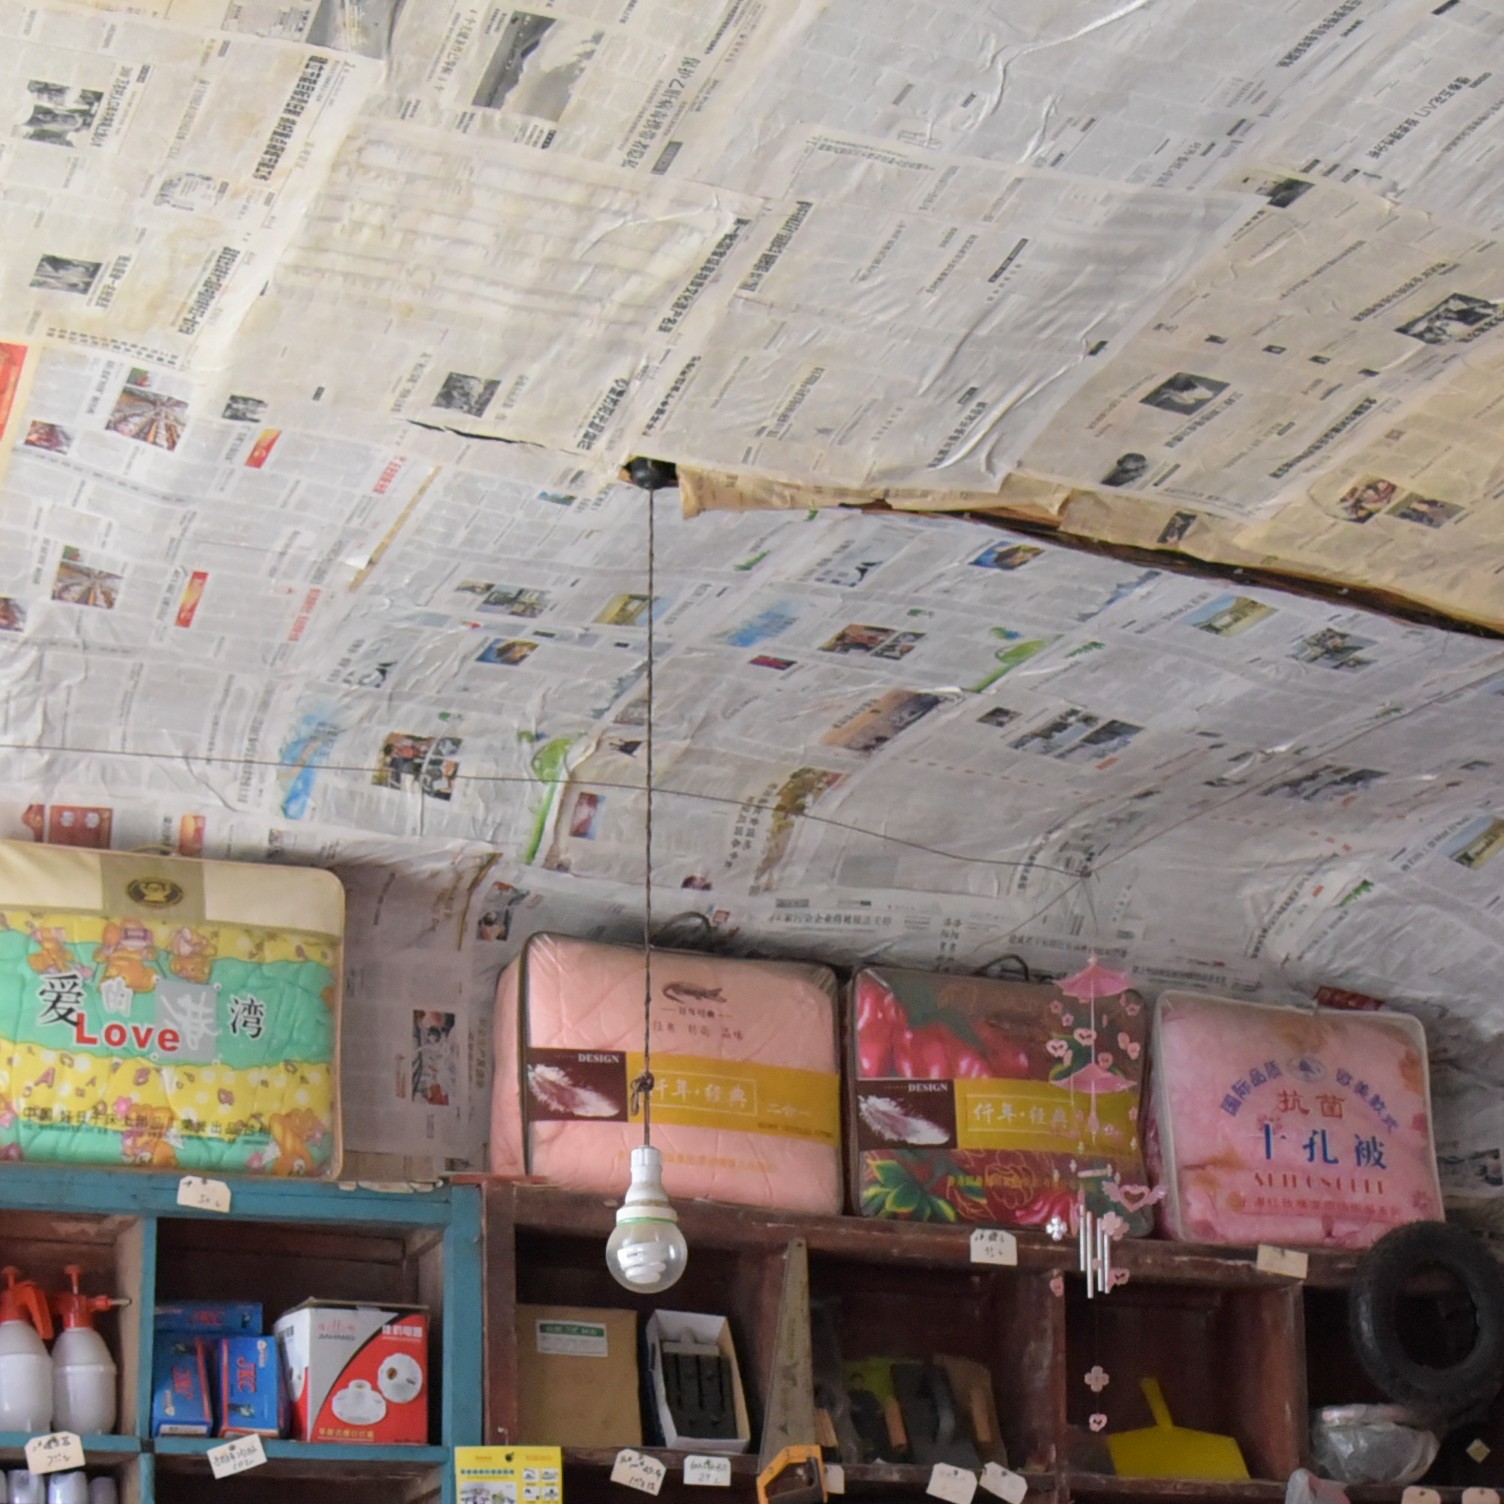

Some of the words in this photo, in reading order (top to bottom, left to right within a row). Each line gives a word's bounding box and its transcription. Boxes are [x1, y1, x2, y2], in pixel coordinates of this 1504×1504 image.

[75, 1014, 181, 1052] Love
[578, 1053, 621, 1066] DESIGN
[906, 1083, 949, 1095] DESIGN
[1220, 1059, 1285, 1117] 国际品质
[1277, 1090, 1345, 1119] 抗菌
[1334, 1067, 1400, 1135] 欧美款式
